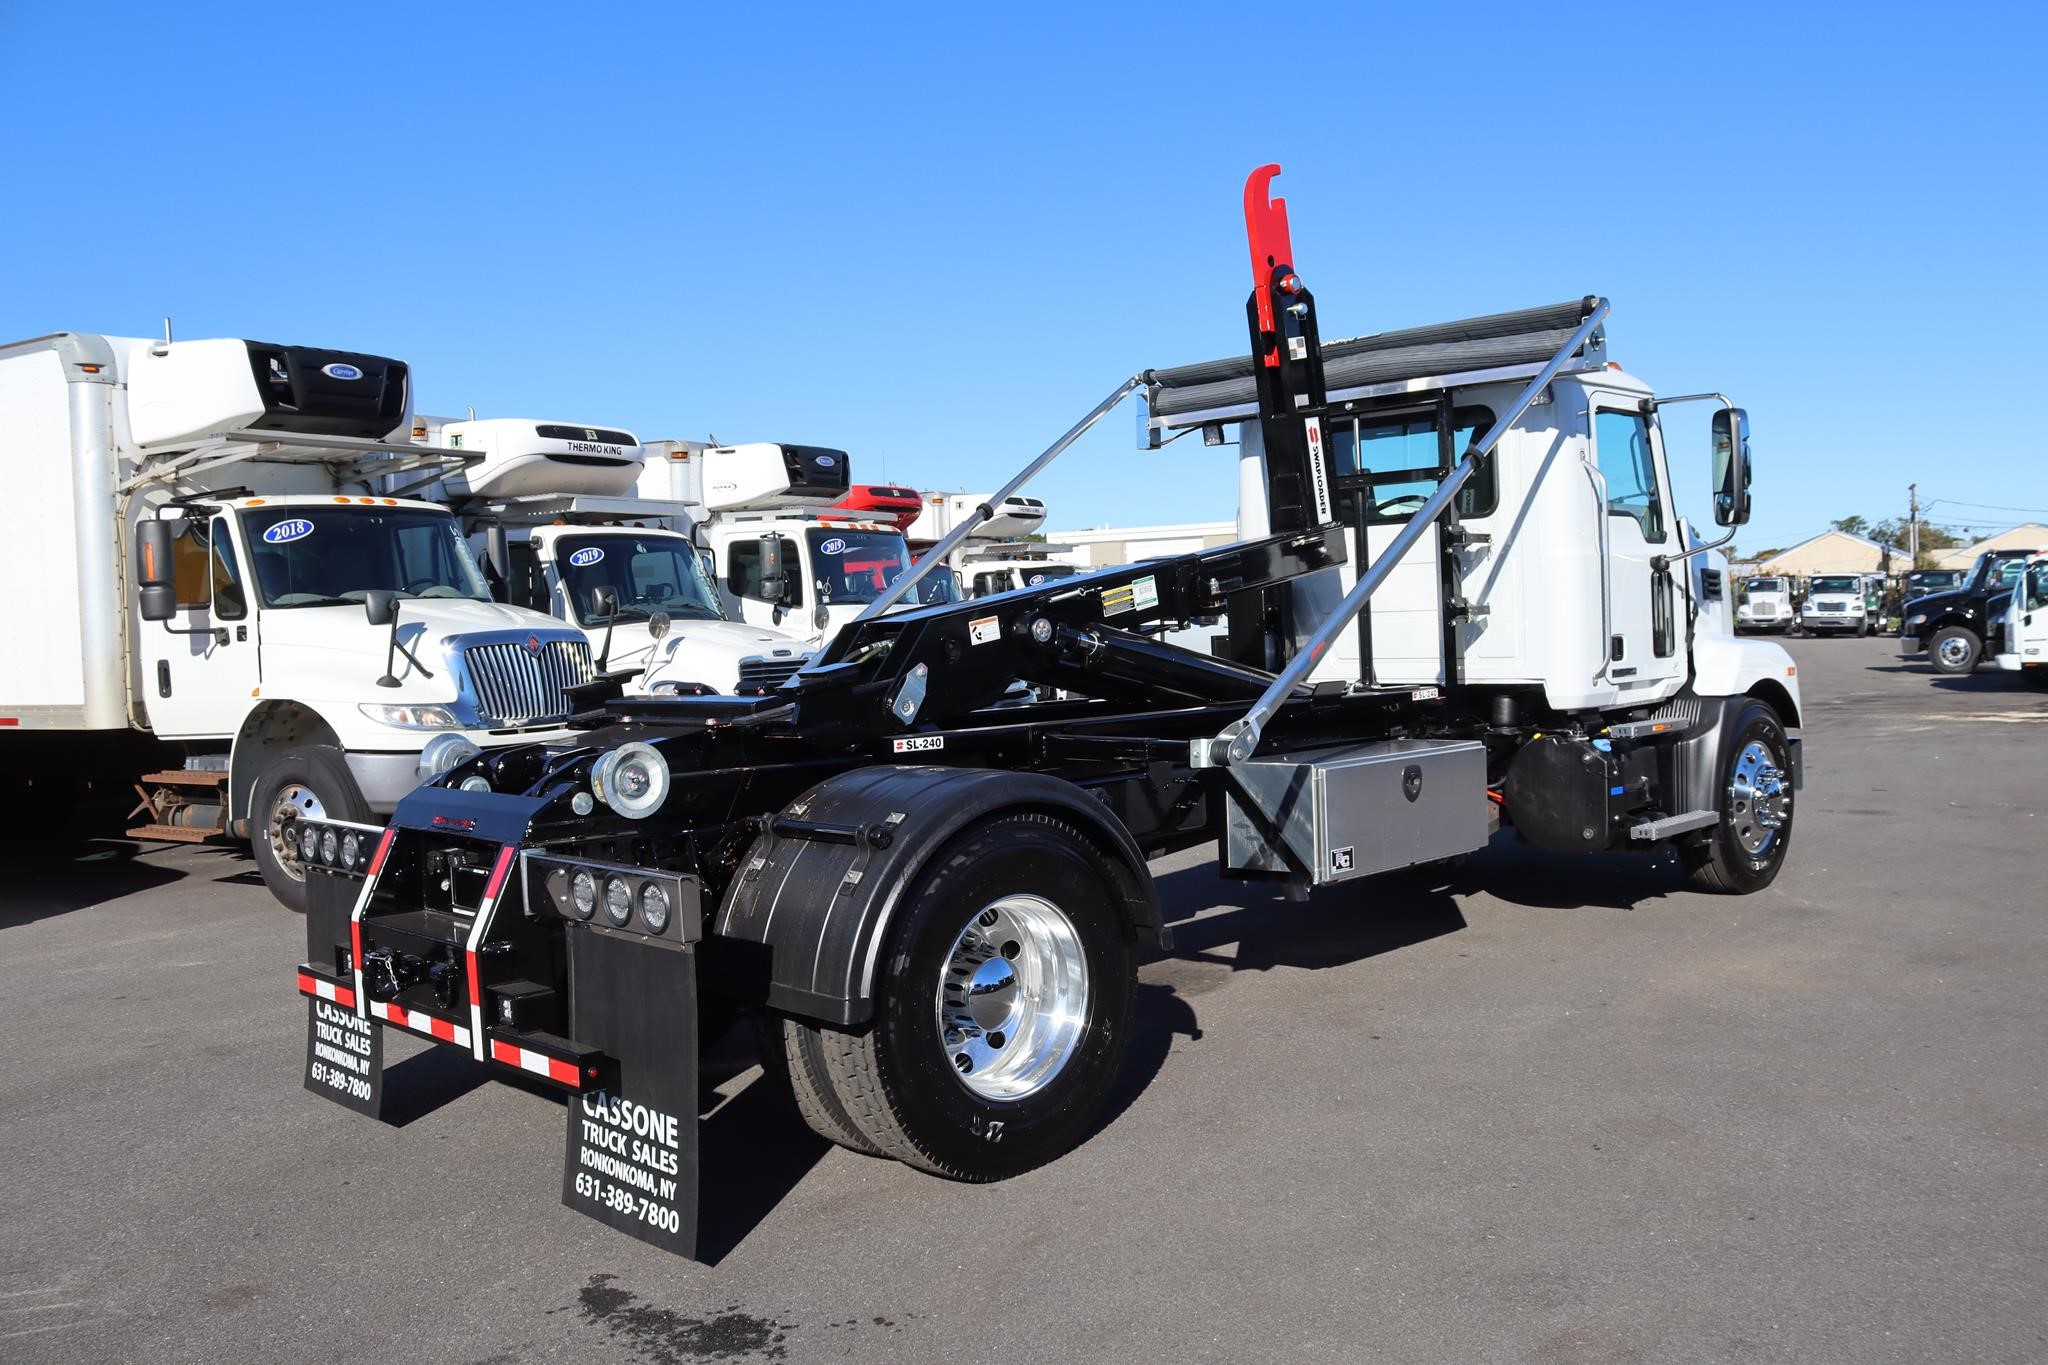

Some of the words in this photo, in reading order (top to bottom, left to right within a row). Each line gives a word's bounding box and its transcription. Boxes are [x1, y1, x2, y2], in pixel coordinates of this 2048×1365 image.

[568, 441, 602, 454] THERMO
[603, 445, 622, 456] KING
[1312, 445, 1327, 515] SWAPLOADER
[273, 521, 305, 541] 2018
[826, 540, 842, 553] 2019
[576, 549, 599, 564] 2019
[906, 737, 942, 750] SL-240
[316, 1021, 343, 1046] TRUCK
[344, 1032, 371, 1056] SALES
[315, 1041, 360, 1075] RONKONKOMA,
[360, 1058, 371, 1076] NY
[311, 1061, 371, 1101] 631-389-7800
[582, 1091, 679, 1149] CASSONE
[581, 1119, 627, 1157] TRUCK
[632, 1139, 679, 1176] SALES
[580, 1145, 659, 1197] RONKONKOMA,
[659, 1178, 677, 1201] NY
[575, 1172, 680, 1234] 631-389-7800
